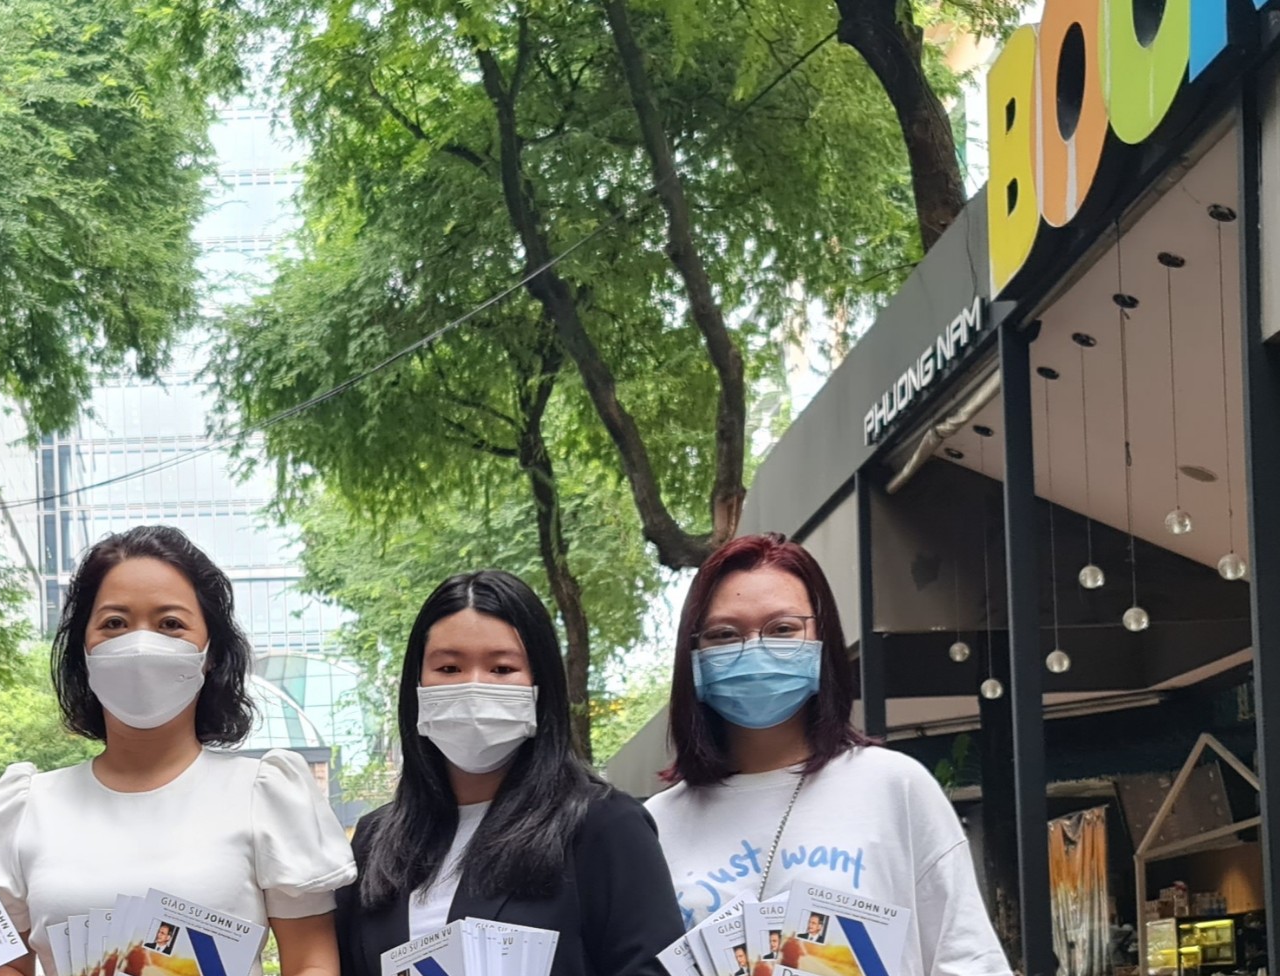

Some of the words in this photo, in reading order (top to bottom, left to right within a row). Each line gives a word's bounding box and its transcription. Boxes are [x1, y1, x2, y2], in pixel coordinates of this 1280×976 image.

[936, 296, 982, 370] NAM
[688, 839, 763, 914] just
[780, 845, 866, 889] want
[851, 898, 880, 913] JOHN
[883, 908, 898, 918] VU
[204, 913, 233, 929] JOHN
[236, 923, 251, 934] VU
[7, 931, 19, 946] VU
[420, 933, 440, 947] JOHN
[442, 927, 452, 937] VU
[502, 937, 514, 945] VU
